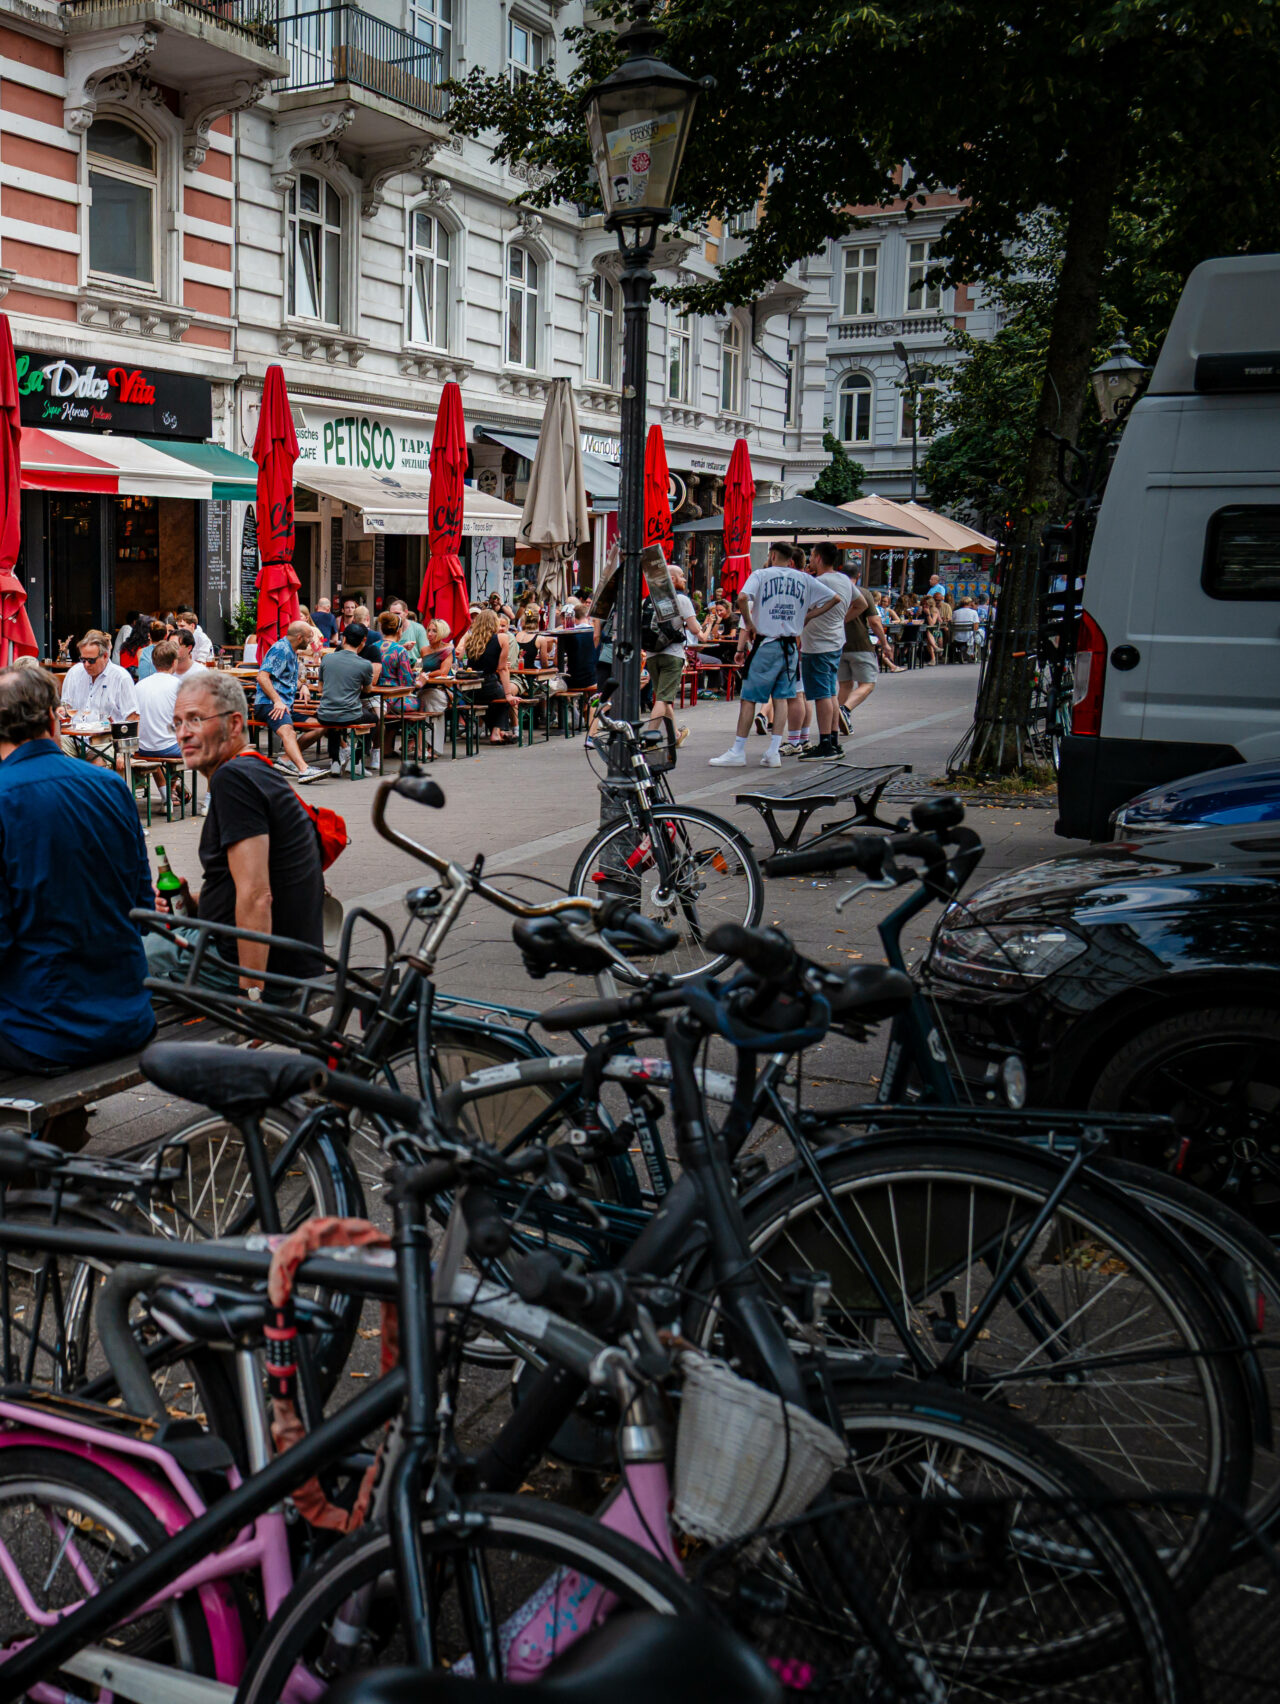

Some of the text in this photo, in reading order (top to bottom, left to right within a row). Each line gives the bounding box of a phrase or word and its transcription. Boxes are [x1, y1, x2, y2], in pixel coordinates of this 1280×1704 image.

[41, 360, 110, 400] Dolce
[107, 367, 156, 406] Vita
[42, 400, 62, 419] Super
[61, 401, 90, 421] Mercato
[296, 428, 319, 440] sisches
[323, 416, 395, 470] PETISCO
[400, 438, 431, 454] TAPA
[786, 577, 805, 601] FAST
